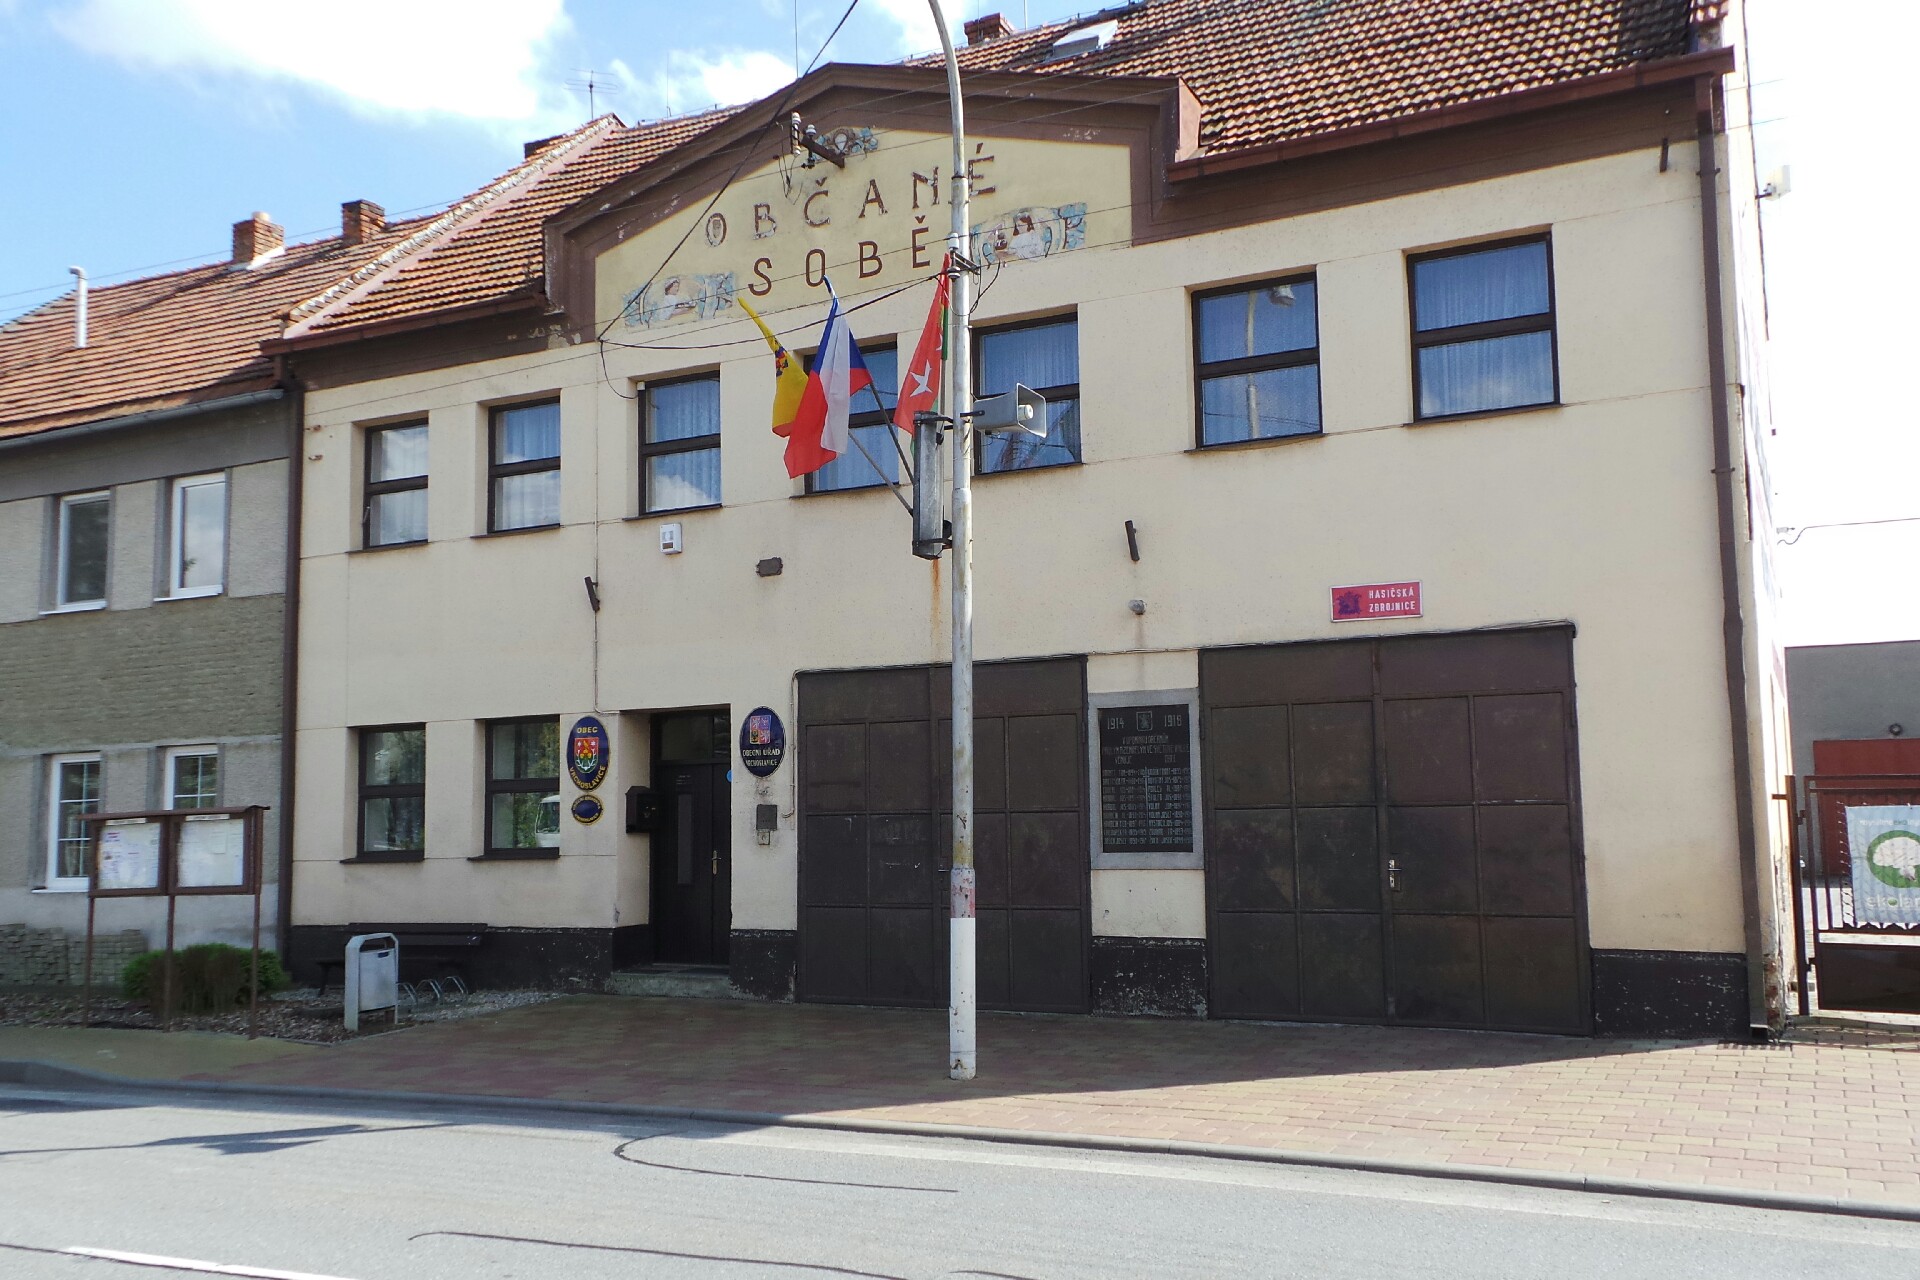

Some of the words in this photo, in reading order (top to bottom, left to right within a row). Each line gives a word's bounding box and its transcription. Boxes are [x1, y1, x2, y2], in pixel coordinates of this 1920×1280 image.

[705, 142, 996, 247] OBČANÉ
[747, 214, 932, 297] SOBĚ
[1369, 587, 1414, 599] HASIČSKÁ
[1369, 601, 1416, 613] ZBROJNICE
[1107, 717, 1125, 730] 1914
[1164, 714, 1182, 727] 1918
[576, 726, 598, 734] OBEC
